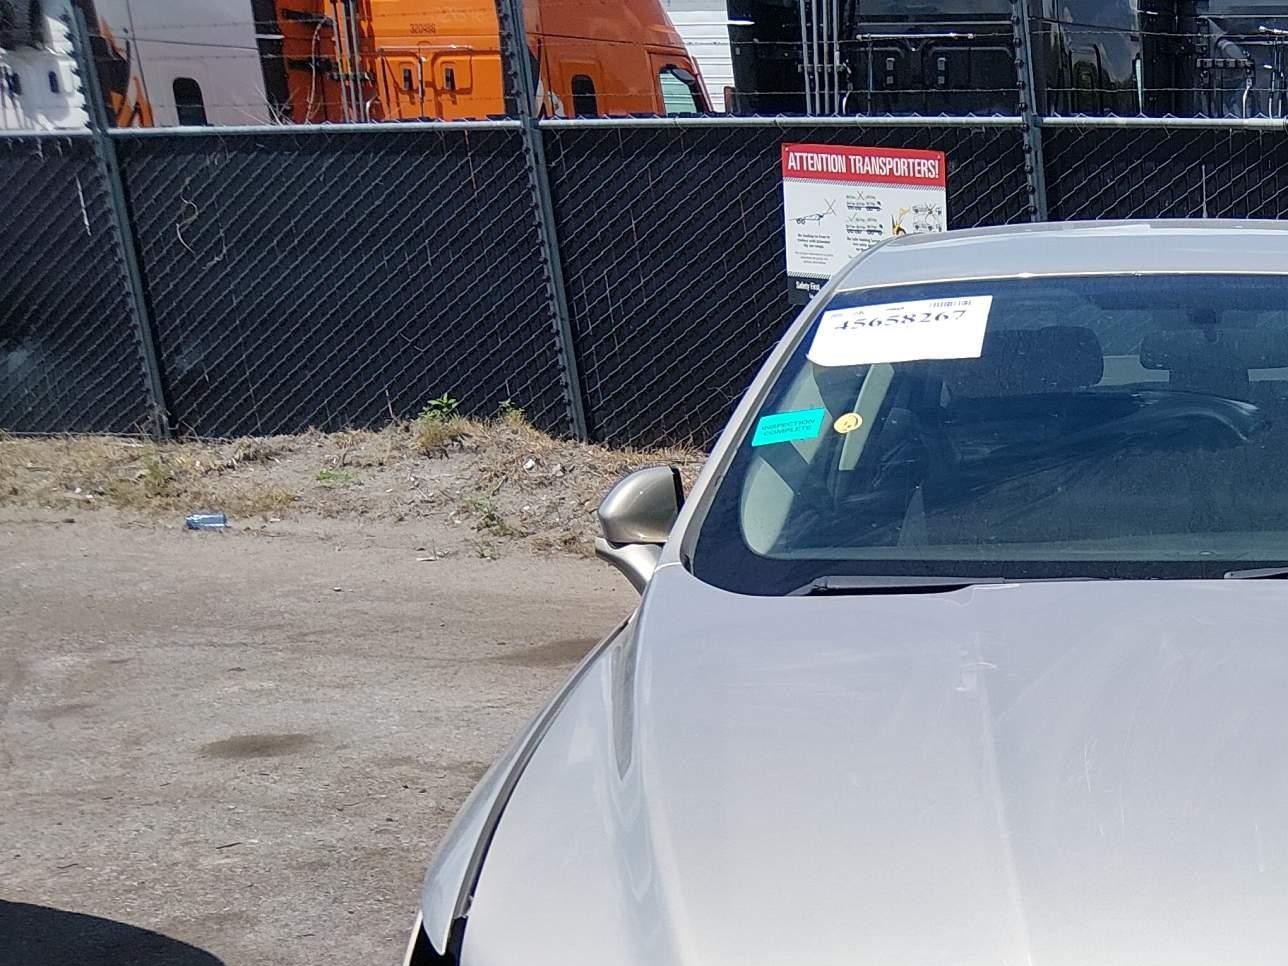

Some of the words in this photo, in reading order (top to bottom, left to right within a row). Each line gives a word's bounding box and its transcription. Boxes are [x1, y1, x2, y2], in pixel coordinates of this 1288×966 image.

[788, 152, 846, 174] ATTENTION
[848, 155, 939, 179] TRANSPORTERS!
[835, 309, 966, 331] 45658267
[761, 418, 816, 431] INSPECTION
[763, 424, 813, 437] COMPLETE
